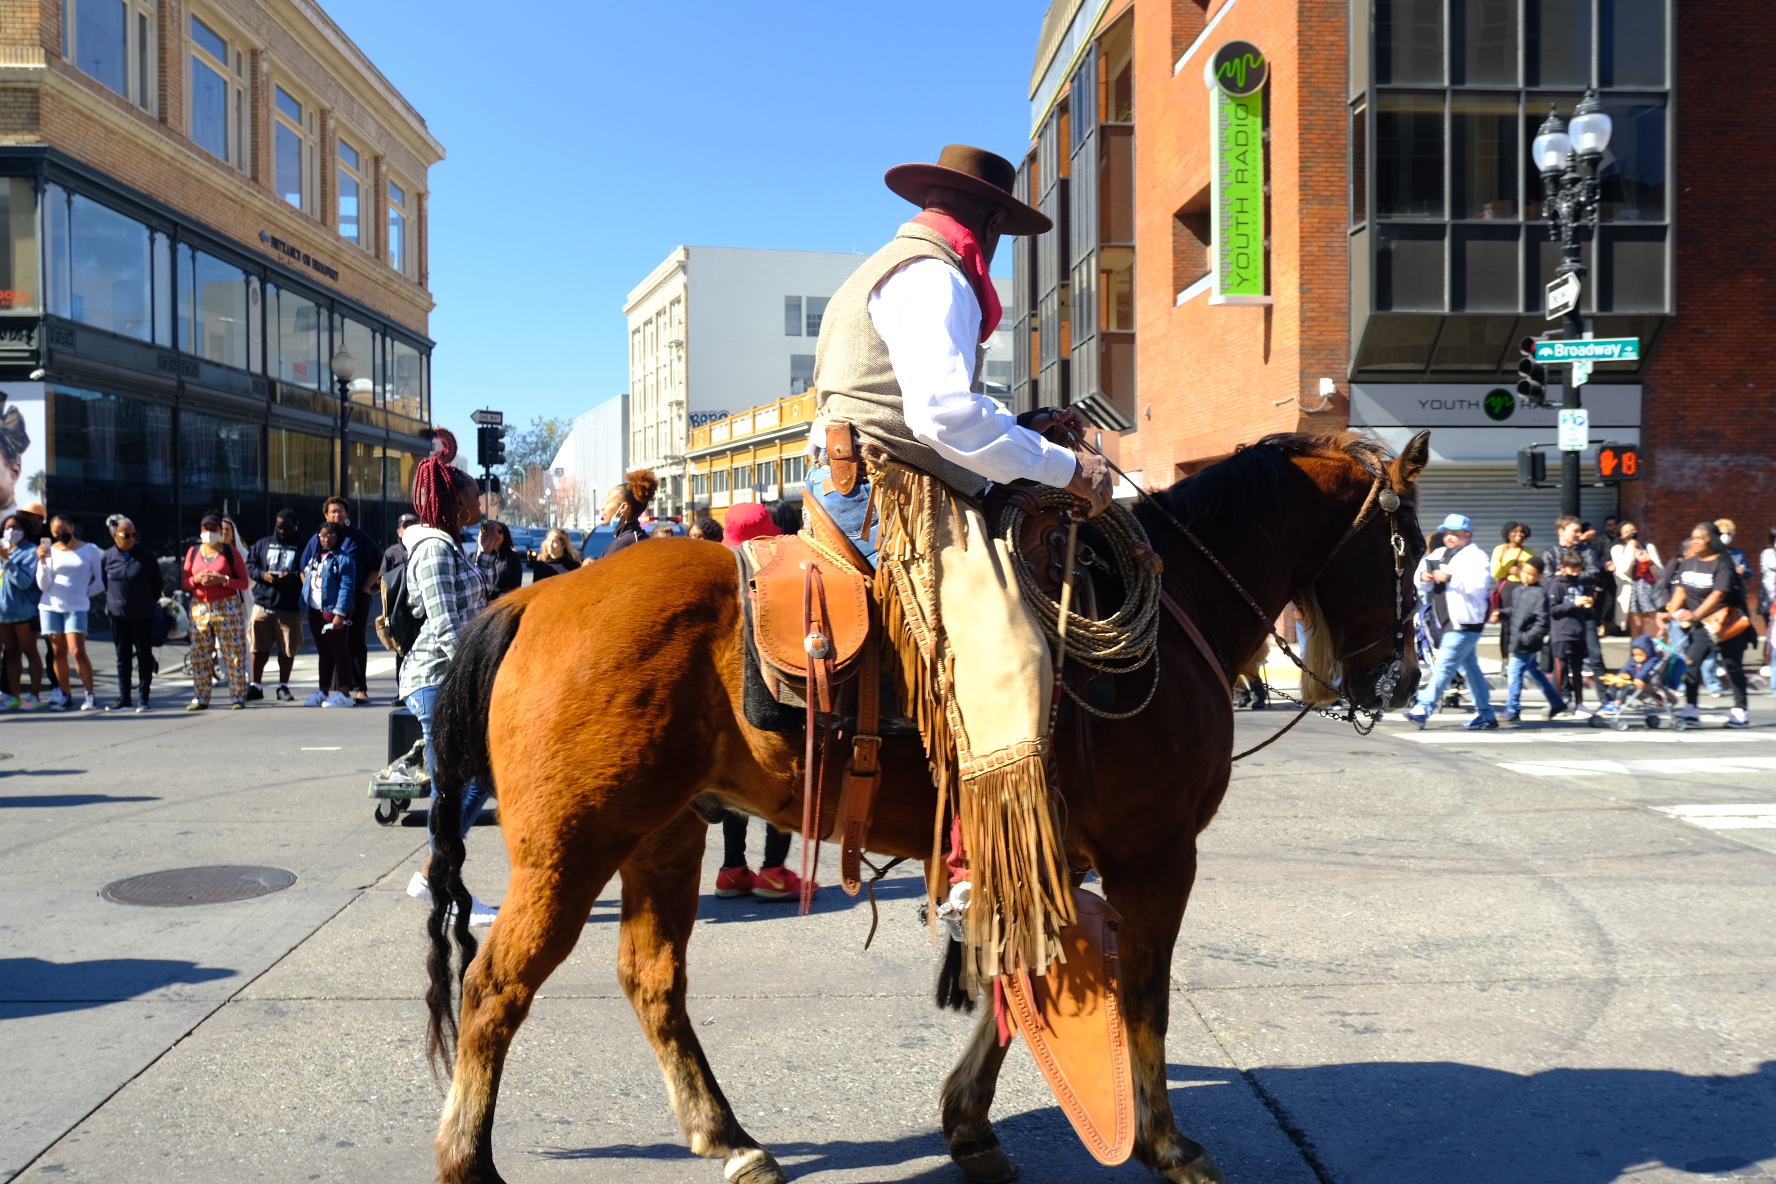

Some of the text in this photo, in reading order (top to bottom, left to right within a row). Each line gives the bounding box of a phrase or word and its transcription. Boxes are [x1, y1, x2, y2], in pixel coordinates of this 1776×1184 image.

[1234, 103, 1250, 288] YOUTH RADIO
[1554, 343, 1622, 358] Broadway
[1418, 399, 1480, 410] YOUTH
